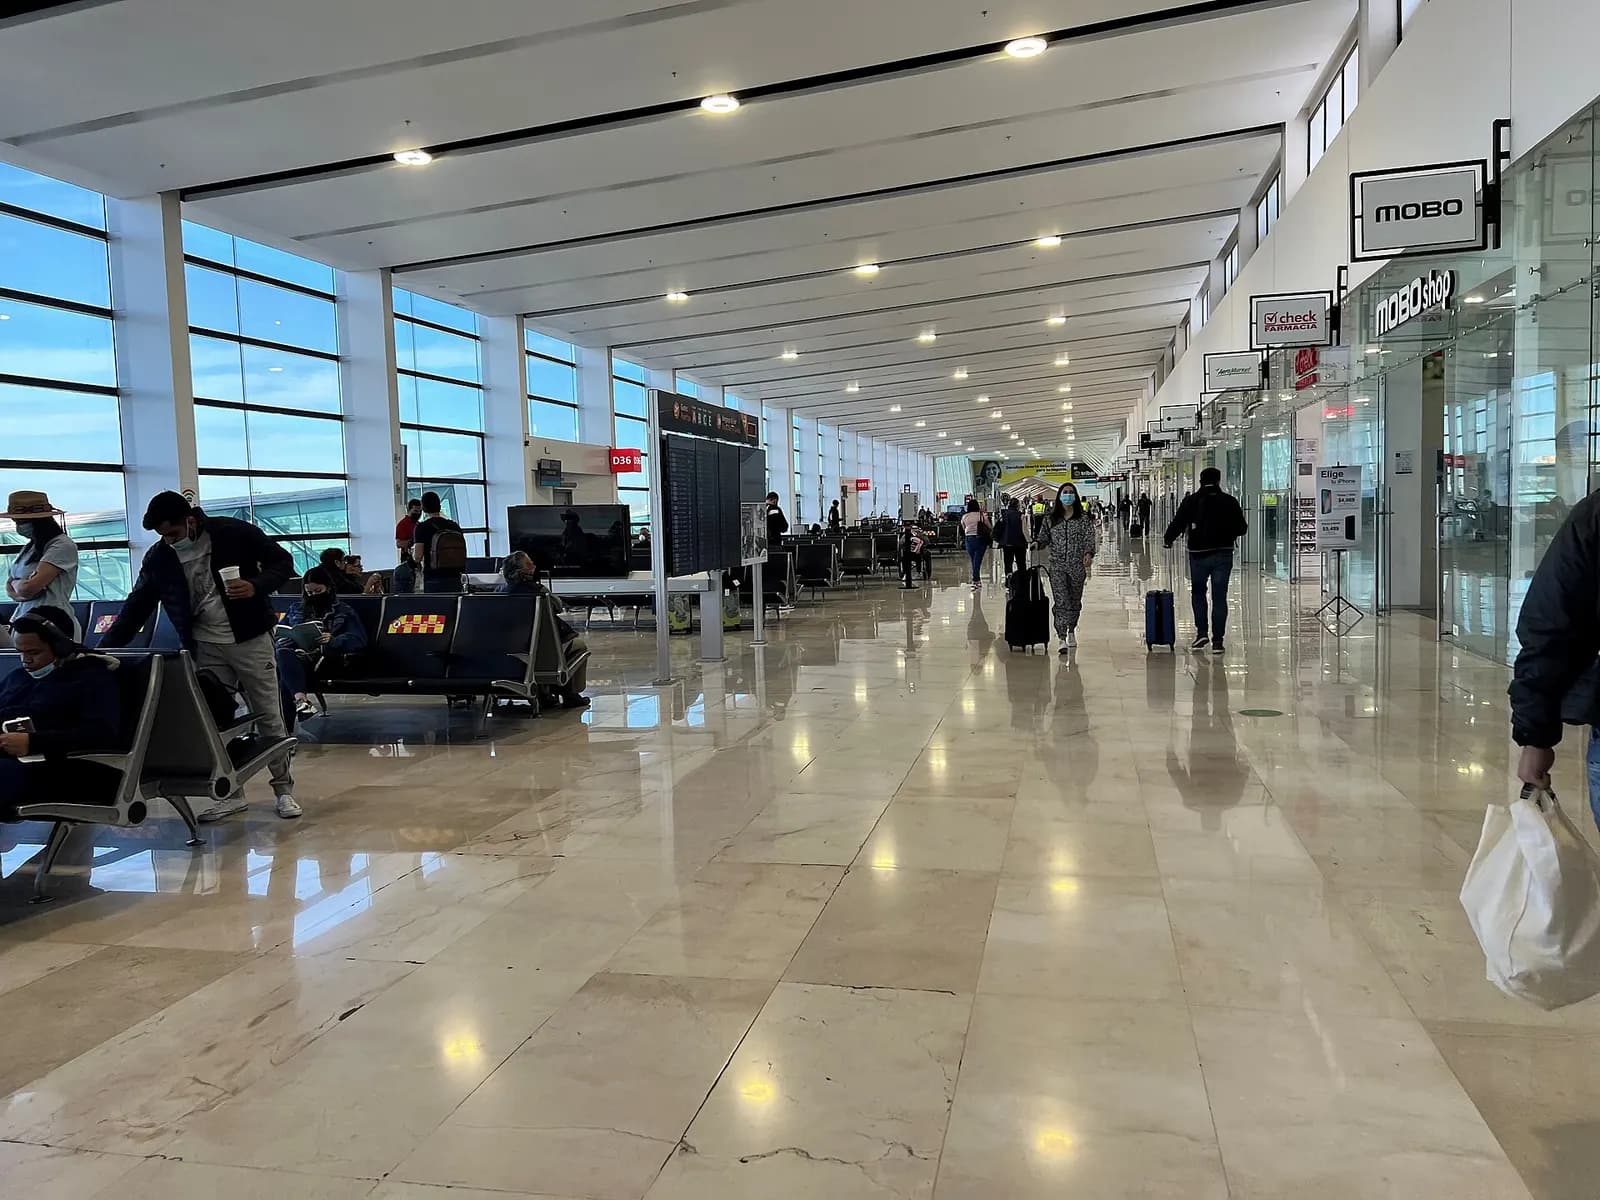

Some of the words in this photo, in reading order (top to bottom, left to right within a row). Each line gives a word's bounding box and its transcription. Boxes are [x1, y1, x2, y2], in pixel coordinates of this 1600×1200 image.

[1375, 198, 1463, 223] MOBO
[1279, 310, 1317, 324] check
[1264, 323, 1318, 332] FARMACIA
[612, 456, 632, 465] D36
[1320, 470, 1344, 480] Elige
